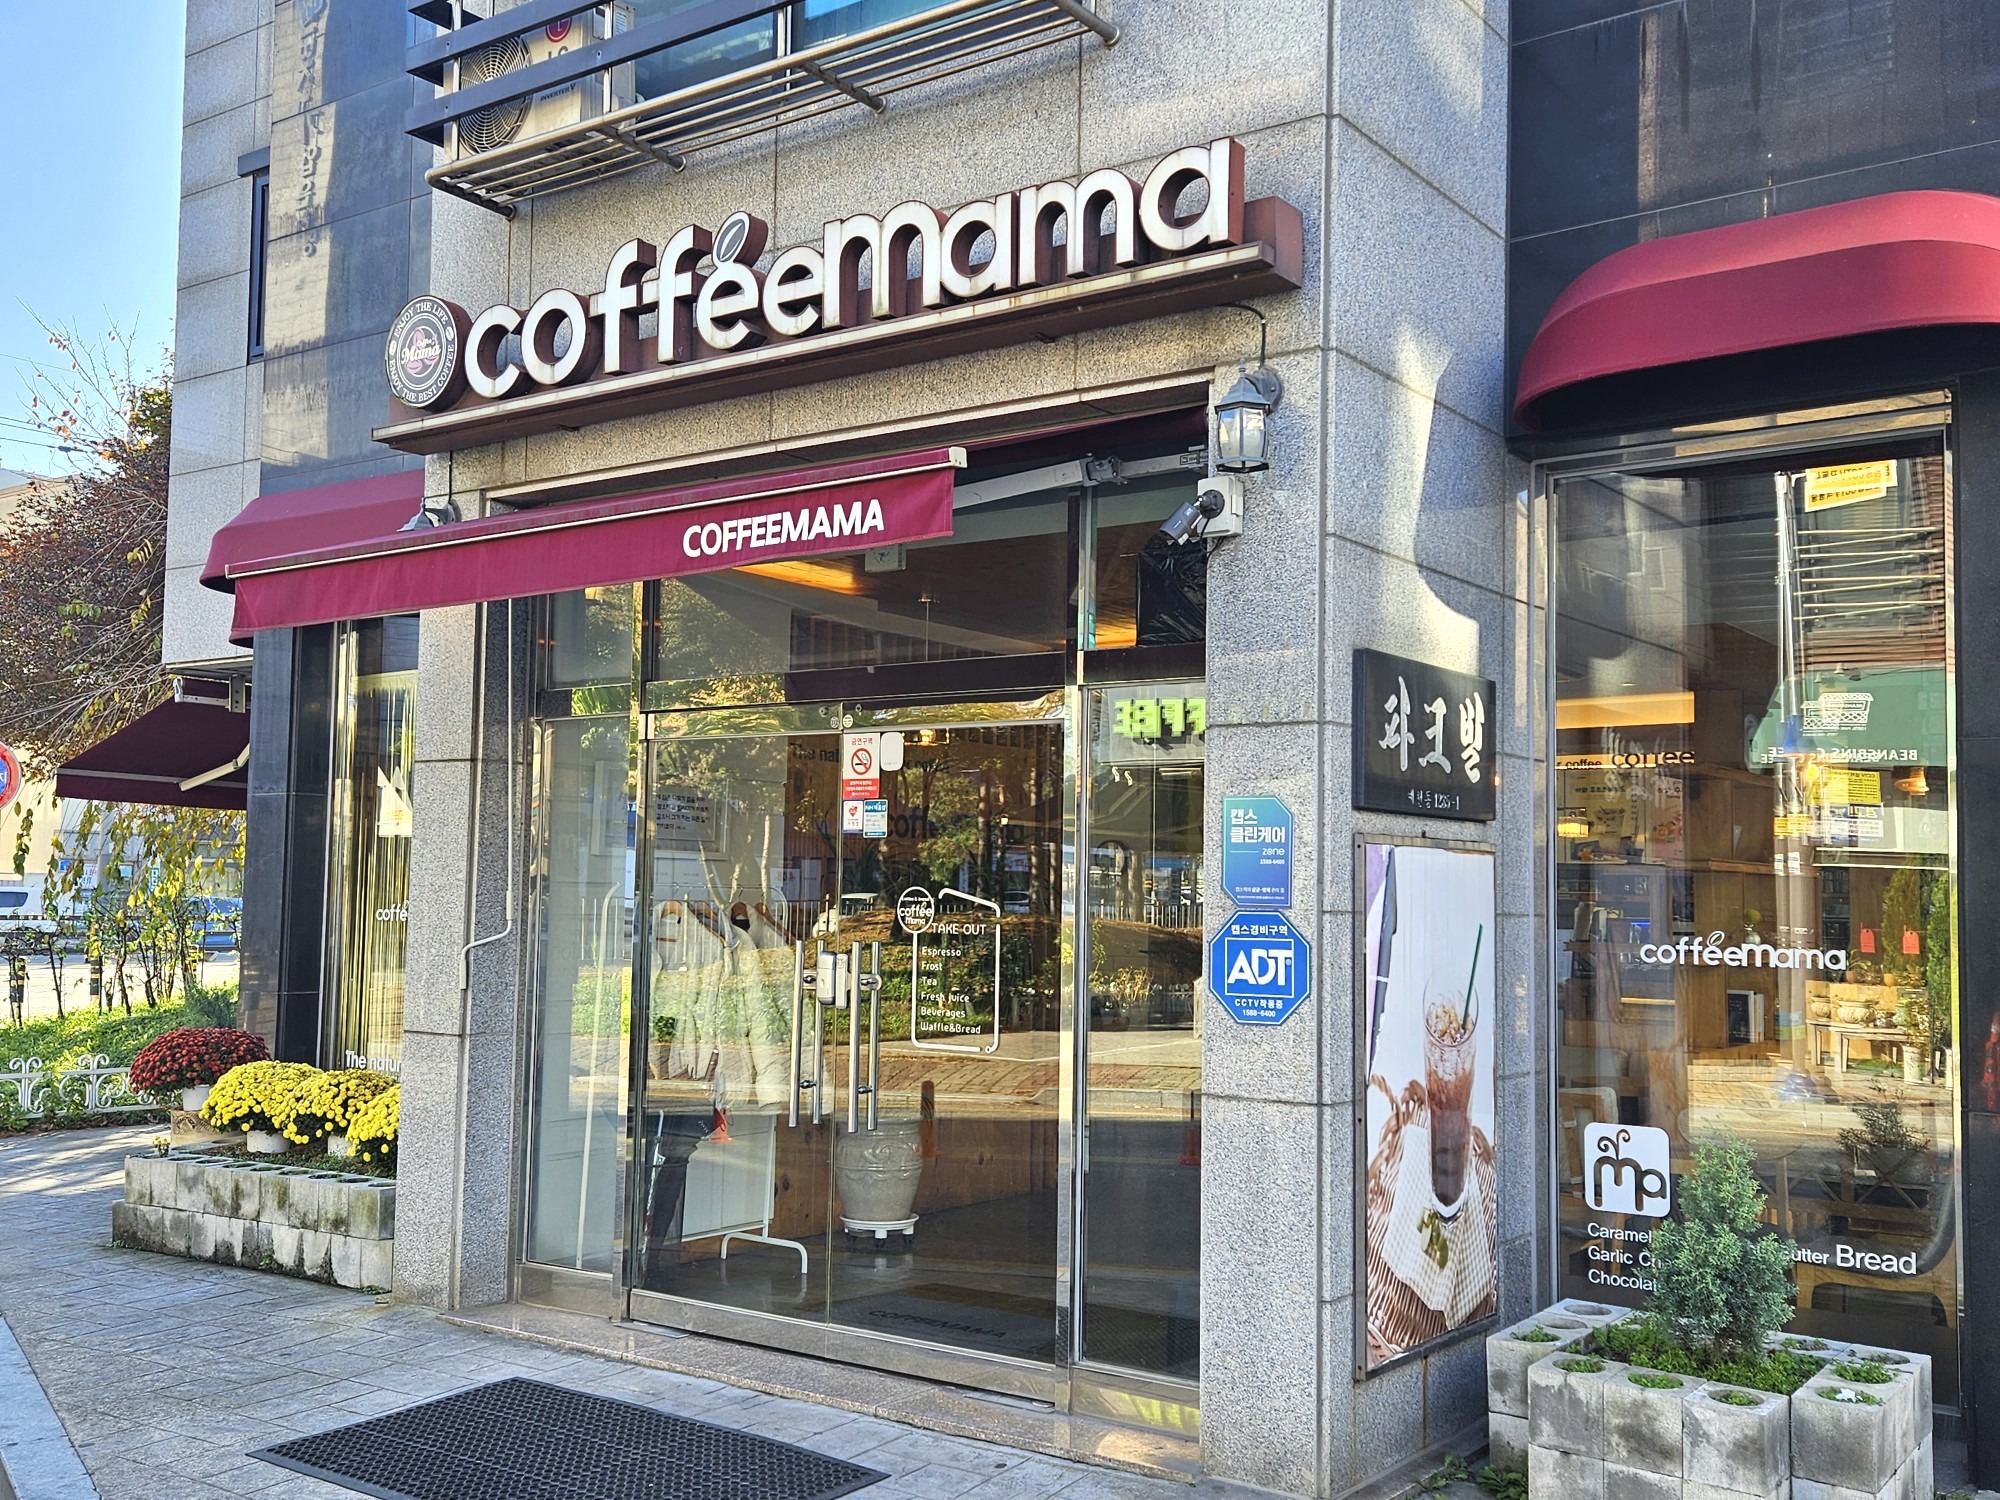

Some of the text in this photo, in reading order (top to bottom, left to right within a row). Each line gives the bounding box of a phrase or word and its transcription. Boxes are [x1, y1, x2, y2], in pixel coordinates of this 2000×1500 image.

[465, 137, 1237, 398] coffeemama
[394, 301, 449, 338] ENJOY THE LIFE
[400, 343, 442, 365] Mama
[388, 344, 455, 402] ENJOY THE BEST COFFEE
[683, 498, 885, 557] COFFEEMAMA
[851, 737, 873, 746] 금연구역
[1230, 808, 1258, 825] 캡스
[1230, 826, 1286, 843] 클린케어
[1262, 847, 1286, 856] zone
[899, 902, 933, 918] coffee
[932, 922, 987, 936] TAKE OUT
[1231, 924, 1288, 936] 캡스경비구역
[921, 946, 962, 957] Espresso
[921, 961, 943, 971] Frost
[1227, 948, 1293, 986] ADT
[922, 976, 938, 986] Tea
[920, 992, 946, 1002] Fresh
[920, 1006, 966, 1018] Beverages
[1242, 1009, 1276, 1017] 1588-6400
[920, 1022, 981, 1034] Waffle&Bread
[346, 1050, 366, 1070] The
[1587, 1222, 1652, 1243] Caramel
[1588, 1245, 1634, 1265] Garlic
[1787, 1243, 1918, 1275] utter Bread
